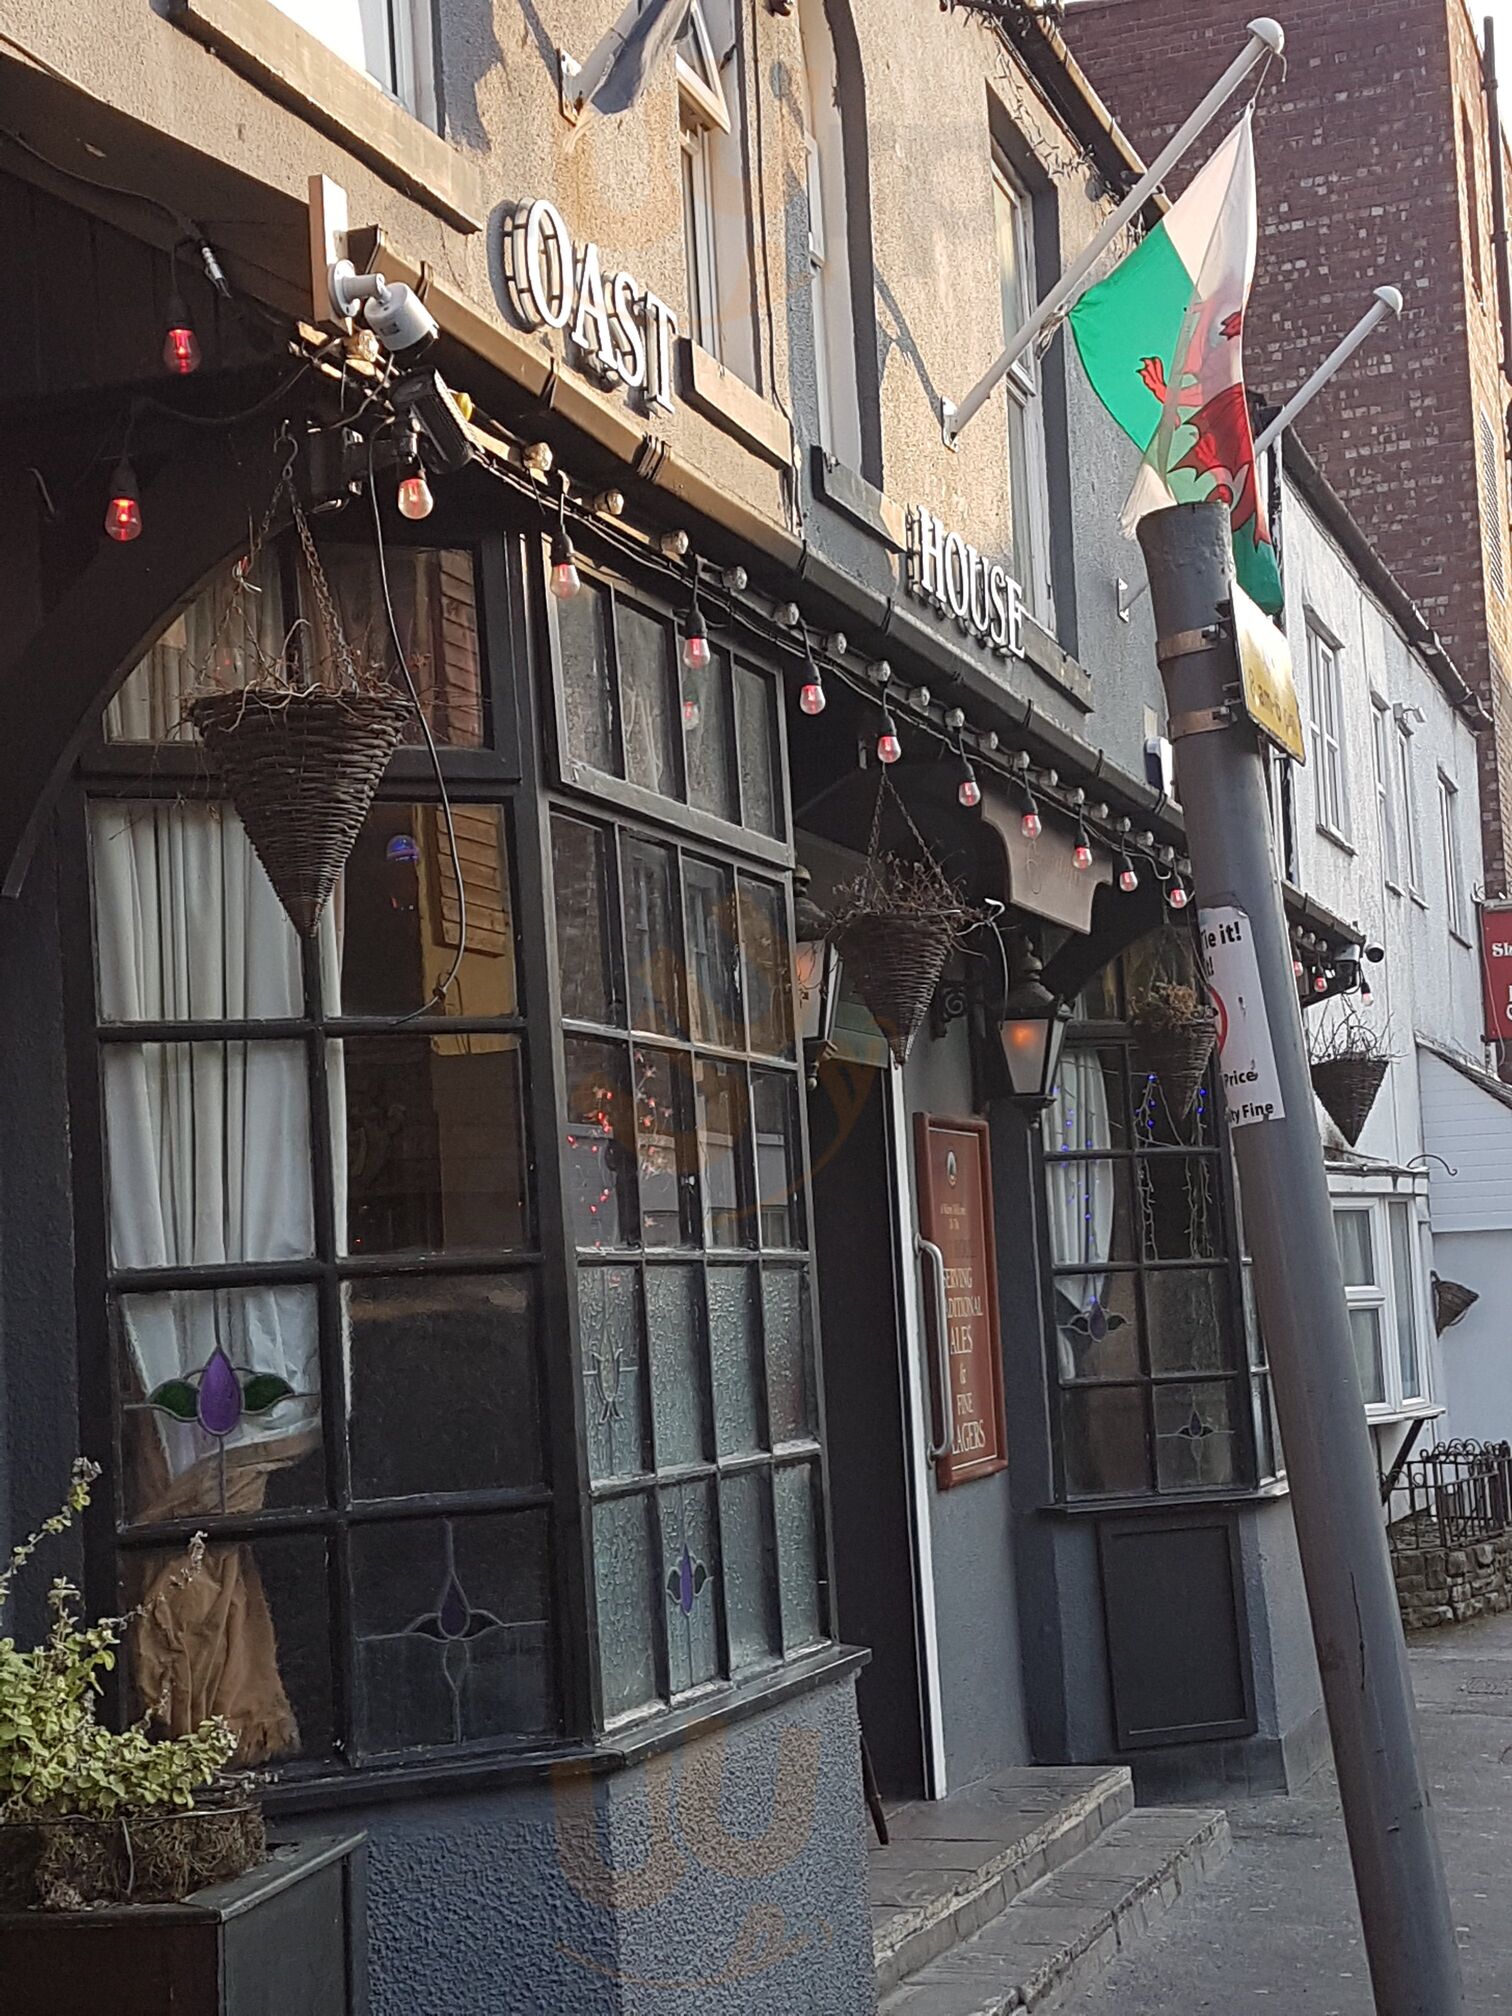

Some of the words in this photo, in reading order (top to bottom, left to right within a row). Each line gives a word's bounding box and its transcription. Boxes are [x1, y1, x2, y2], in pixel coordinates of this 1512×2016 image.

[523, 198, 679, 415] OAST
[915, 503, 1026, 659] HOUSE
[1218, 920, 1242, 945] it!
[1241, 1102, 1274, 1119] Fine
[950, 1324, 973, 1355] ALES
[956, 1392, 974, 1416] FINE
